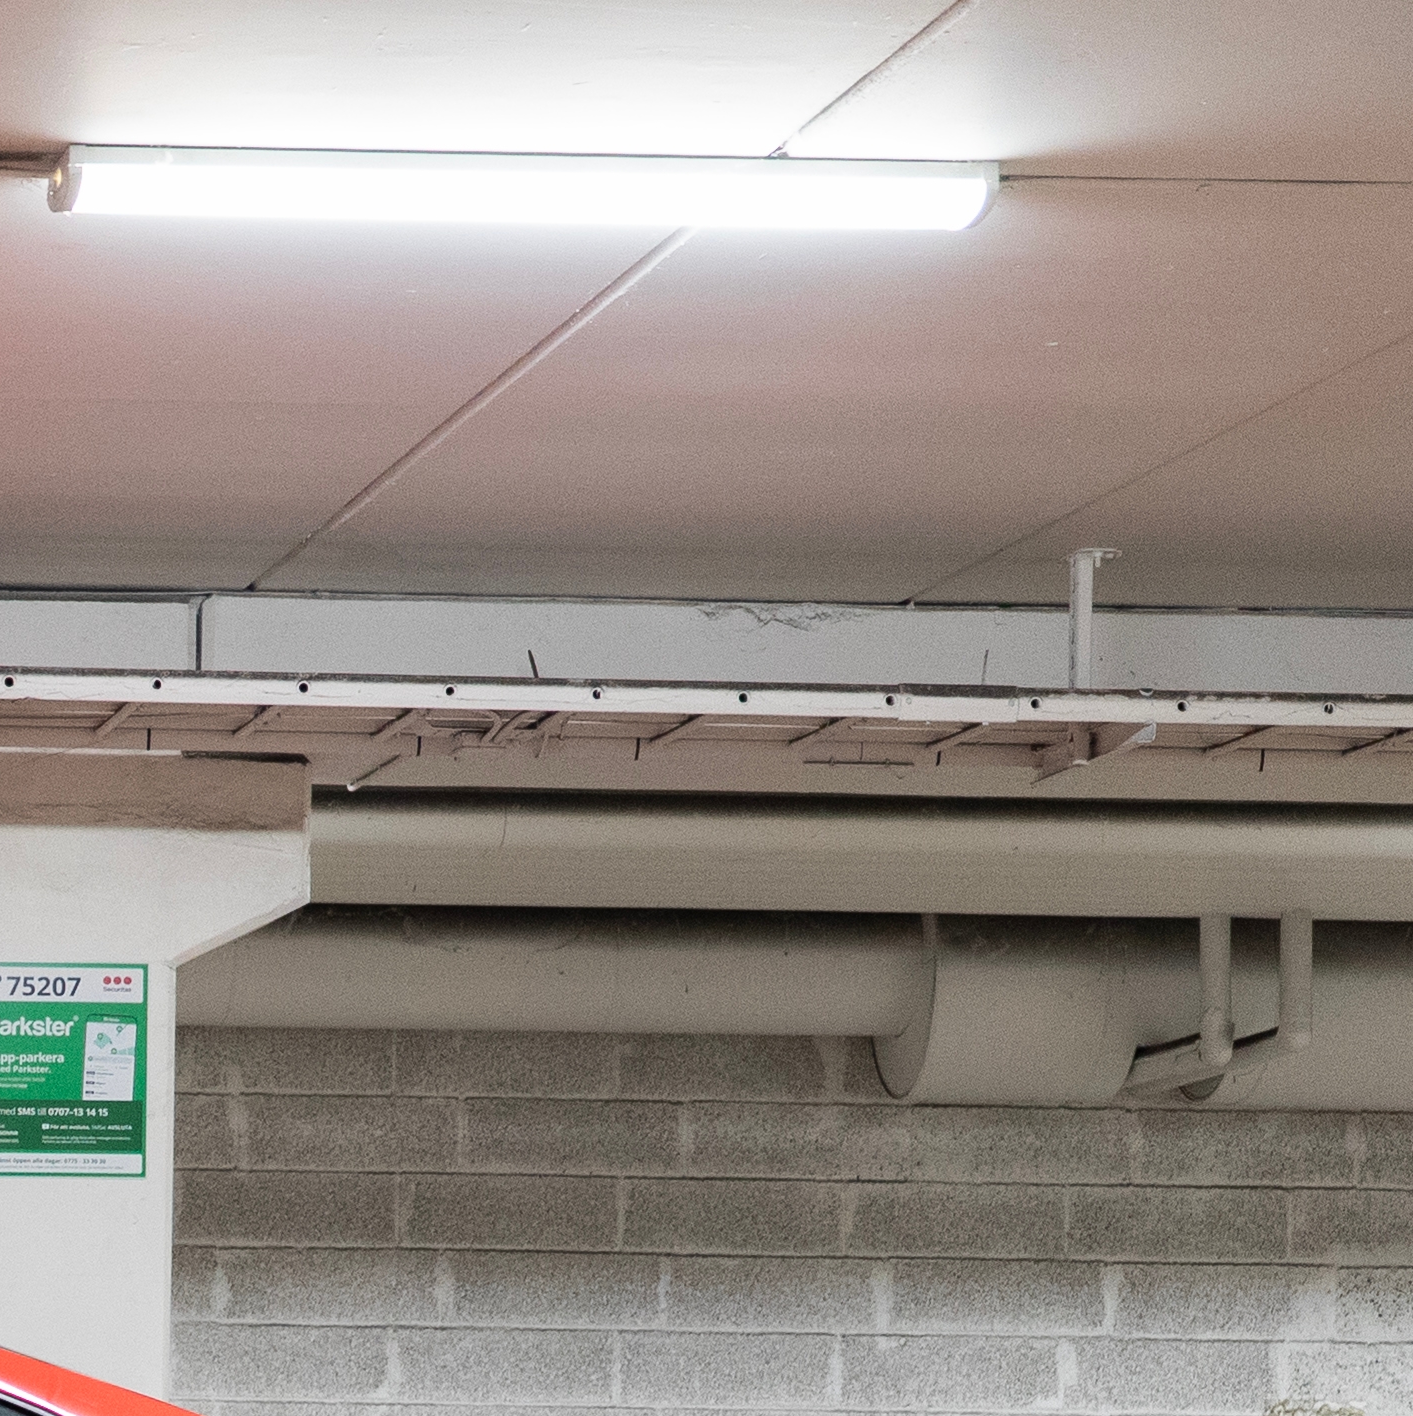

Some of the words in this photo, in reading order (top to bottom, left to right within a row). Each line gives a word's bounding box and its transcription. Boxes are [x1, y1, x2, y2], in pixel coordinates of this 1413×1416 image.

[7, 976, 82, 997] 75207
[12, 1065, 52, 1074] Parkster.
[17, 1108, 36, 1116] SMS
[37, 1108, 47, 1116] till
[48, 1108, 84, 1117] 0707-13
[85, 1108, 97, 1117] 14
[98, 1108, 109, 1117] 15
